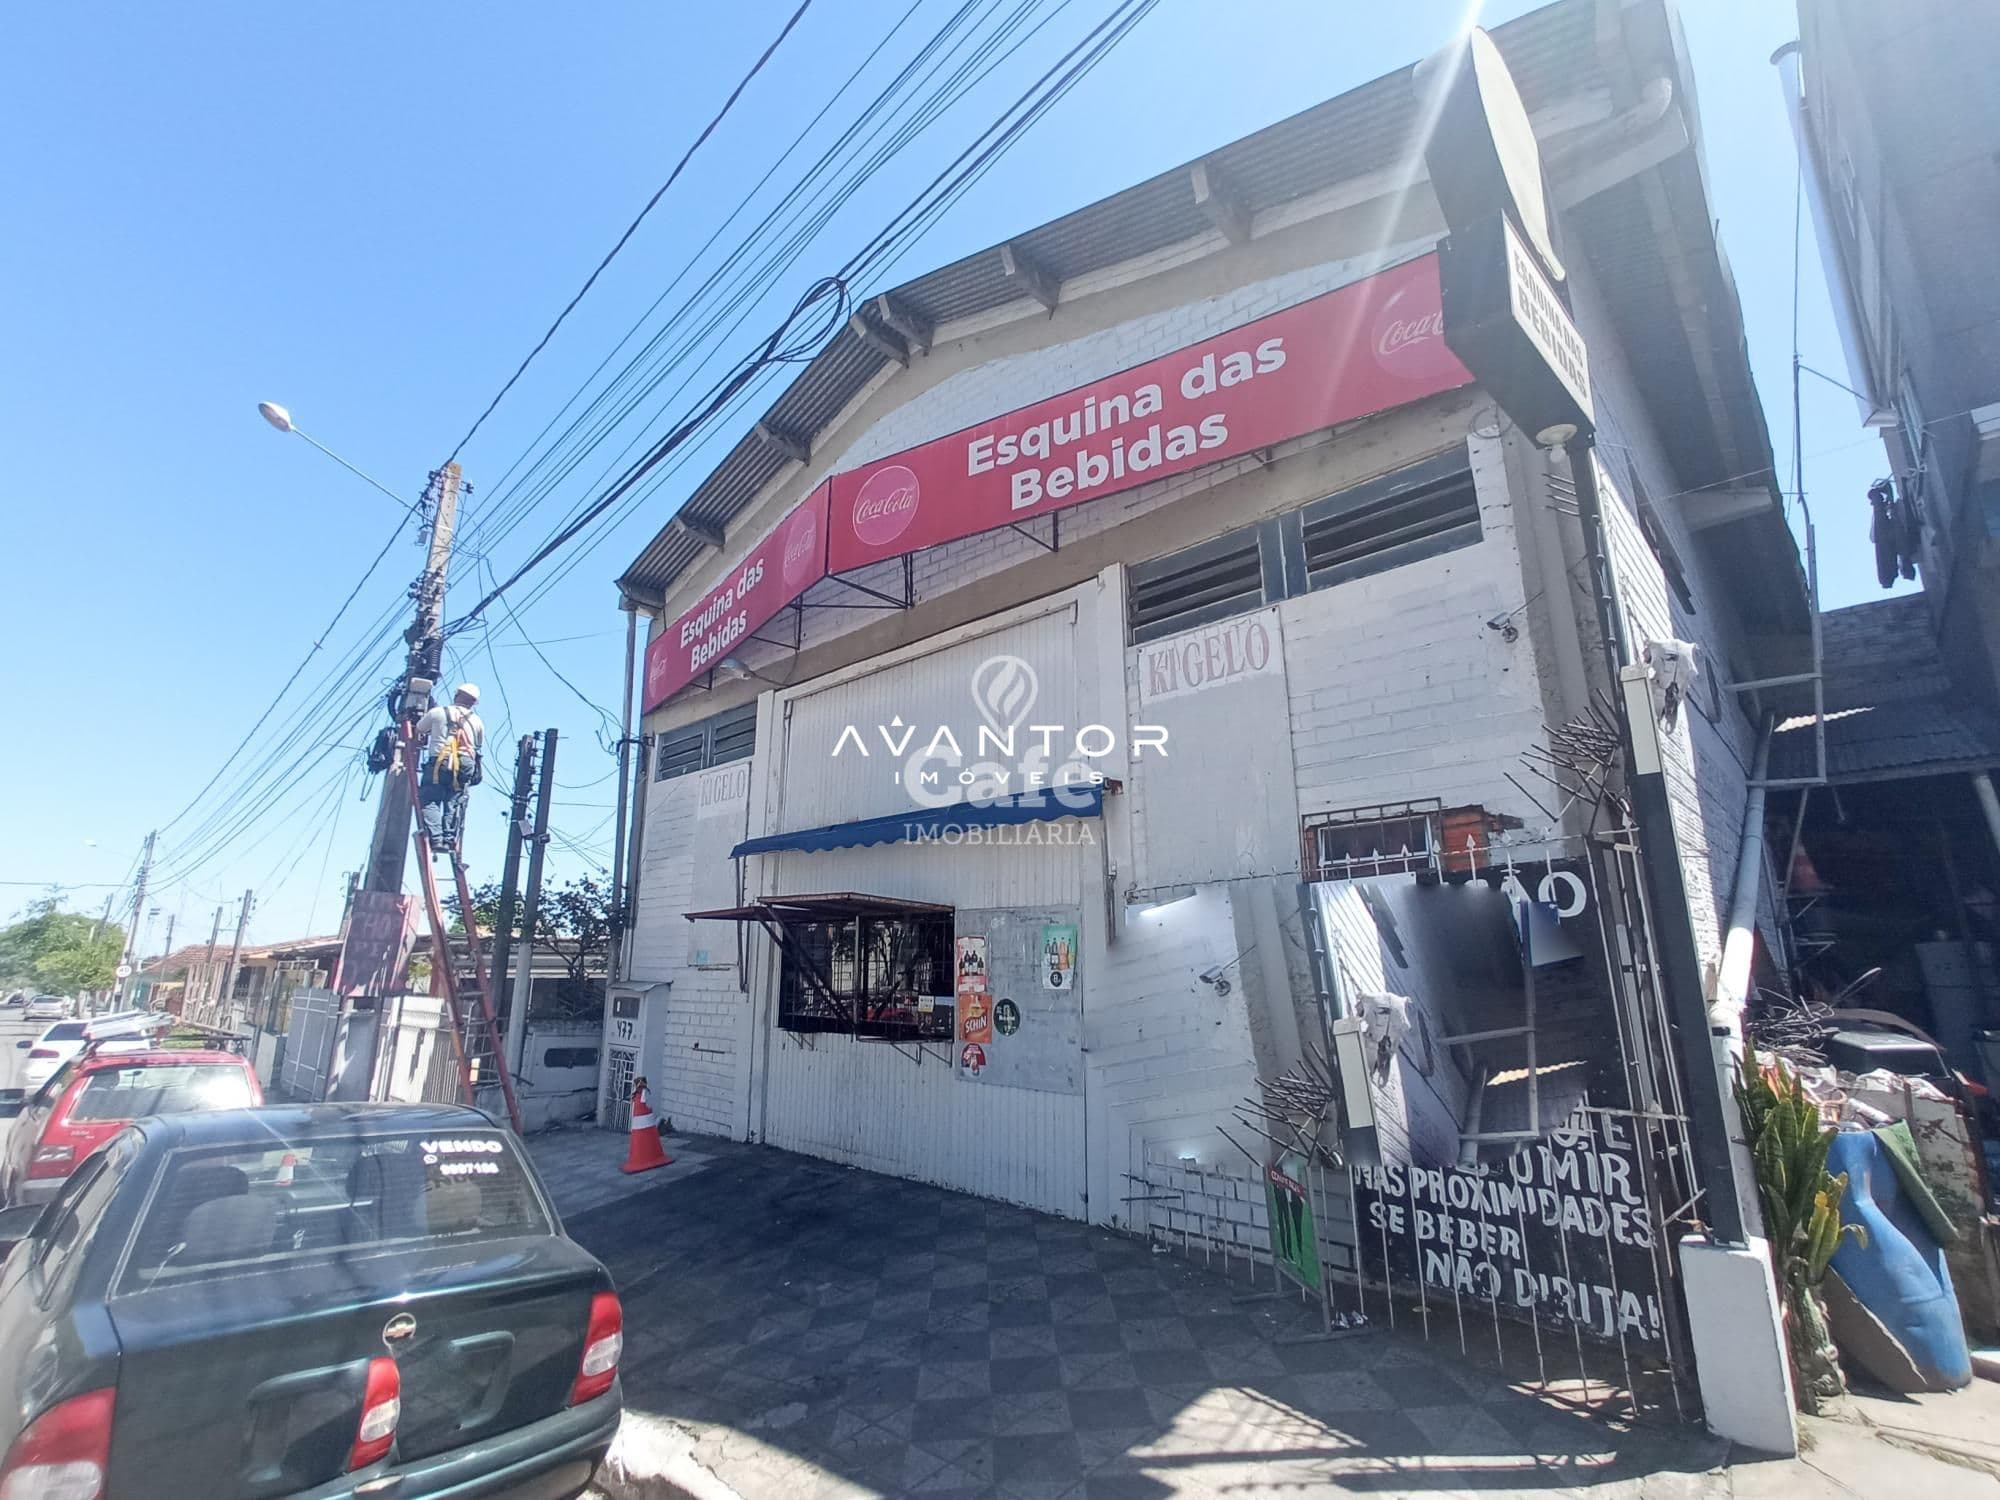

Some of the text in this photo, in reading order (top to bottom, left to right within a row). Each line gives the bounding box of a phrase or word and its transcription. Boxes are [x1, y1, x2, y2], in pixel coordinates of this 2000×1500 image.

[1513, 250, 1563, 338] ESQUINA
[1517, 282, 1588, 400] BEBIDAS
[967, 336, 1287, 477] Esquina das
[1010, 413, 1229, 511] Bebidas
[680, 558, 764, 648] Esquina das
[690, 610, 747, 673] Bebidas
[965, 1015, 988, 1034] SCHIN
[420, 1139, 503, 1154] VENDO
[1370, 1201, 1521, 1260] SE BEBER
[1411, 1166, 1656, 1249] PROXIMIDADES
[1424, 1249, 1502, 1297] NÃO
